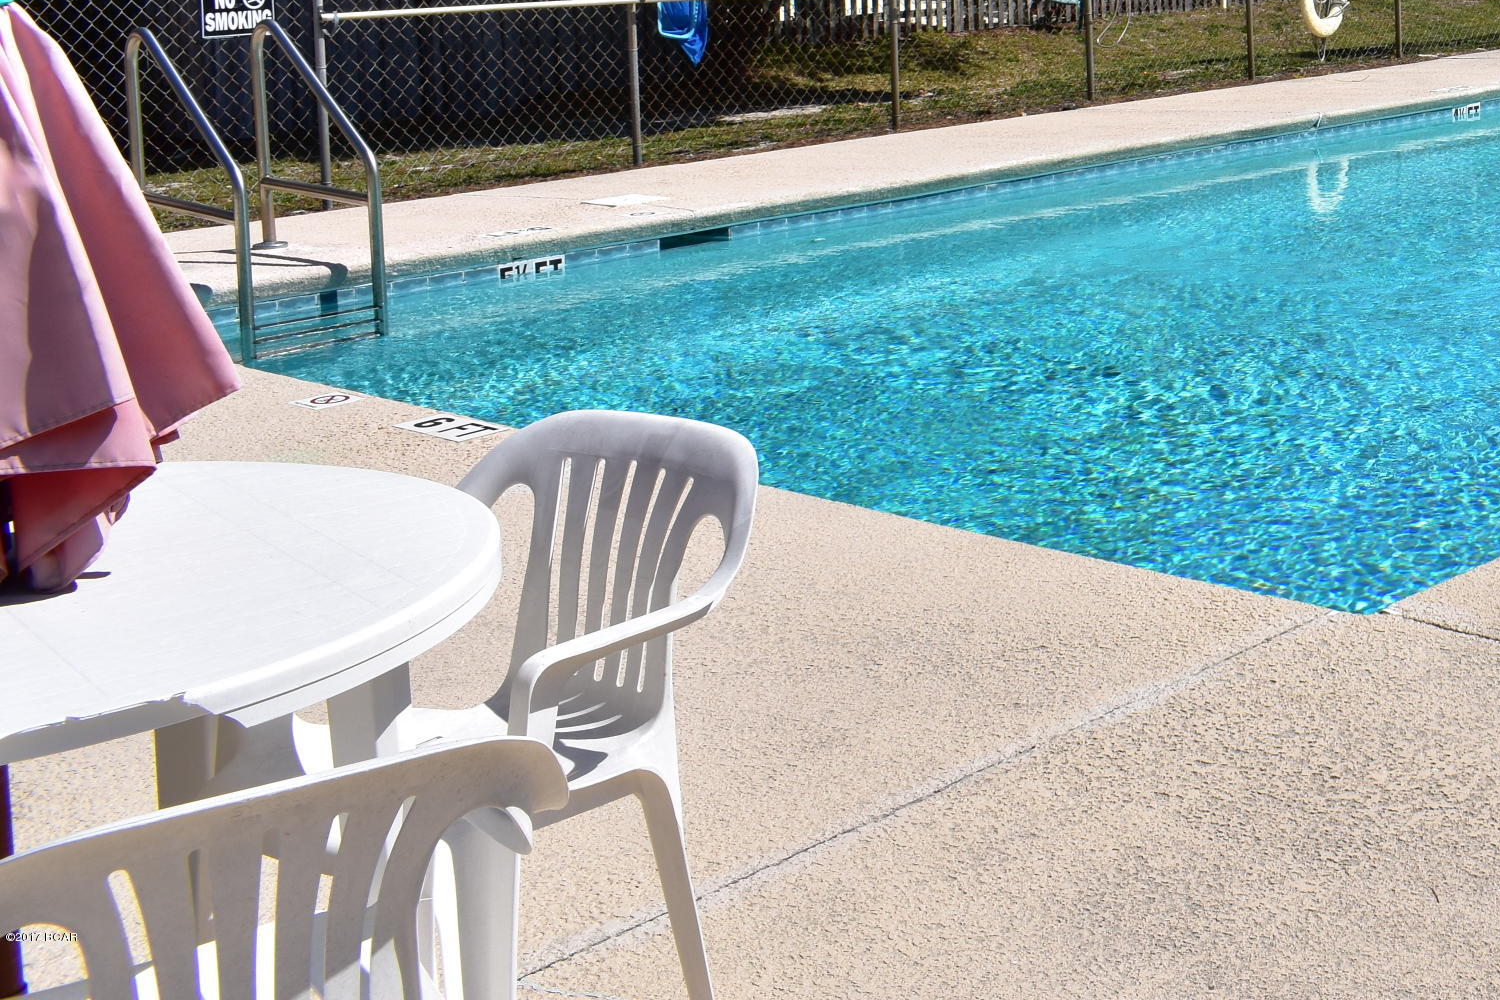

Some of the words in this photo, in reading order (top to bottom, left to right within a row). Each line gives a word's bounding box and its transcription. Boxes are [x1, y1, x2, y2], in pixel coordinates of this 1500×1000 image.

[204, 9, 273, 32] SMOKING
[413, 416, 456, 429] 6
[437, 422, 499, 438] FT
